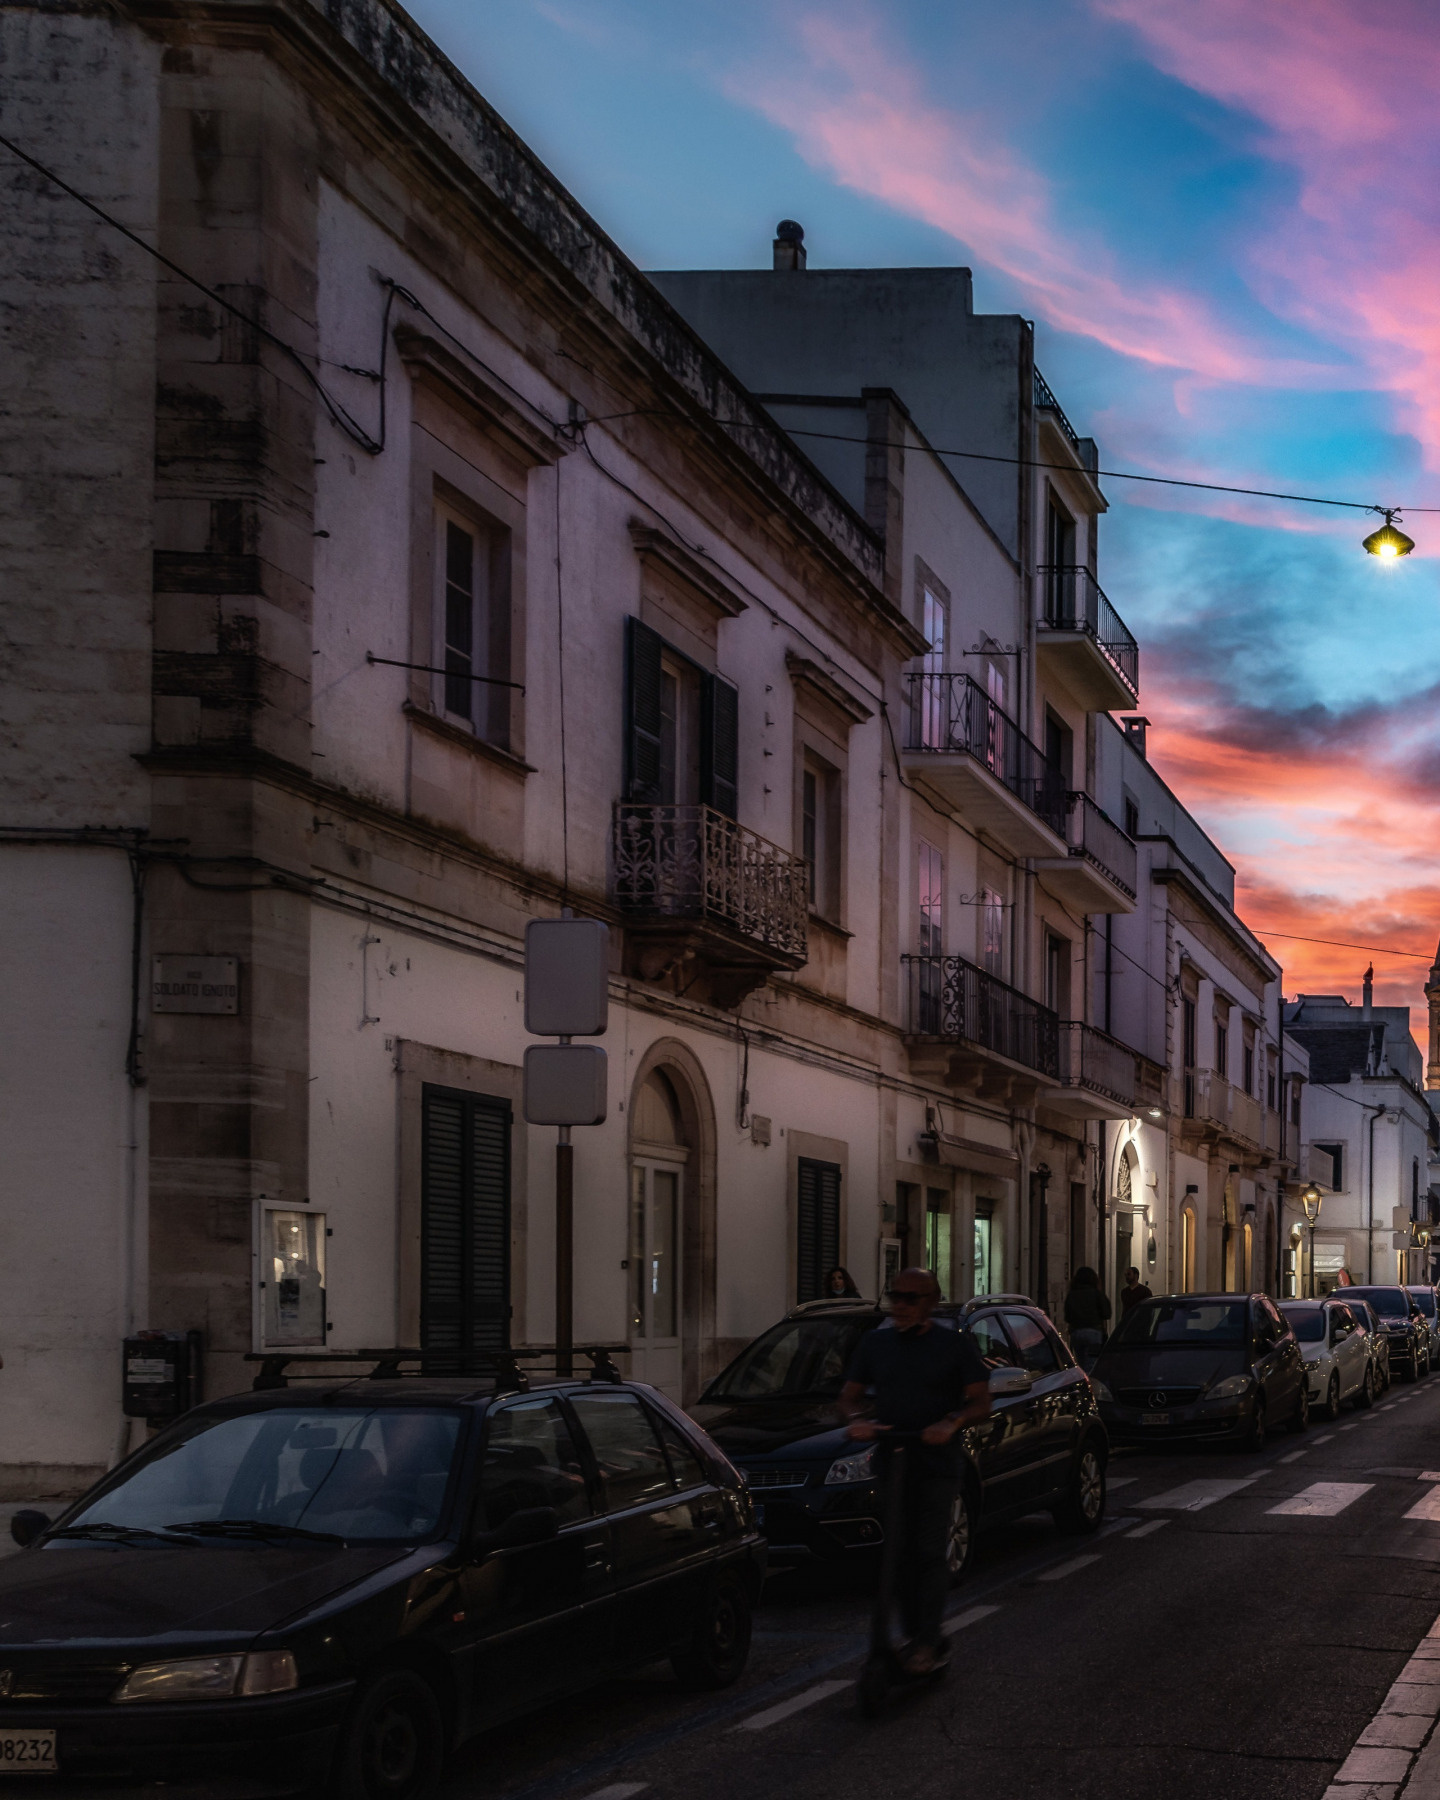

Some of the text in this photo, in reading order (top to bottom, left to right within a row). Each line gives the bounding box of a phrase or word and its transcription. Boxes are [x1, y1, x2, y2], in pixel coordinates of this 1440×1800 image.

[153, 982, 236, 998] SOLDATO IGNOTO
[0, 1739, 53, 1761] 8232
